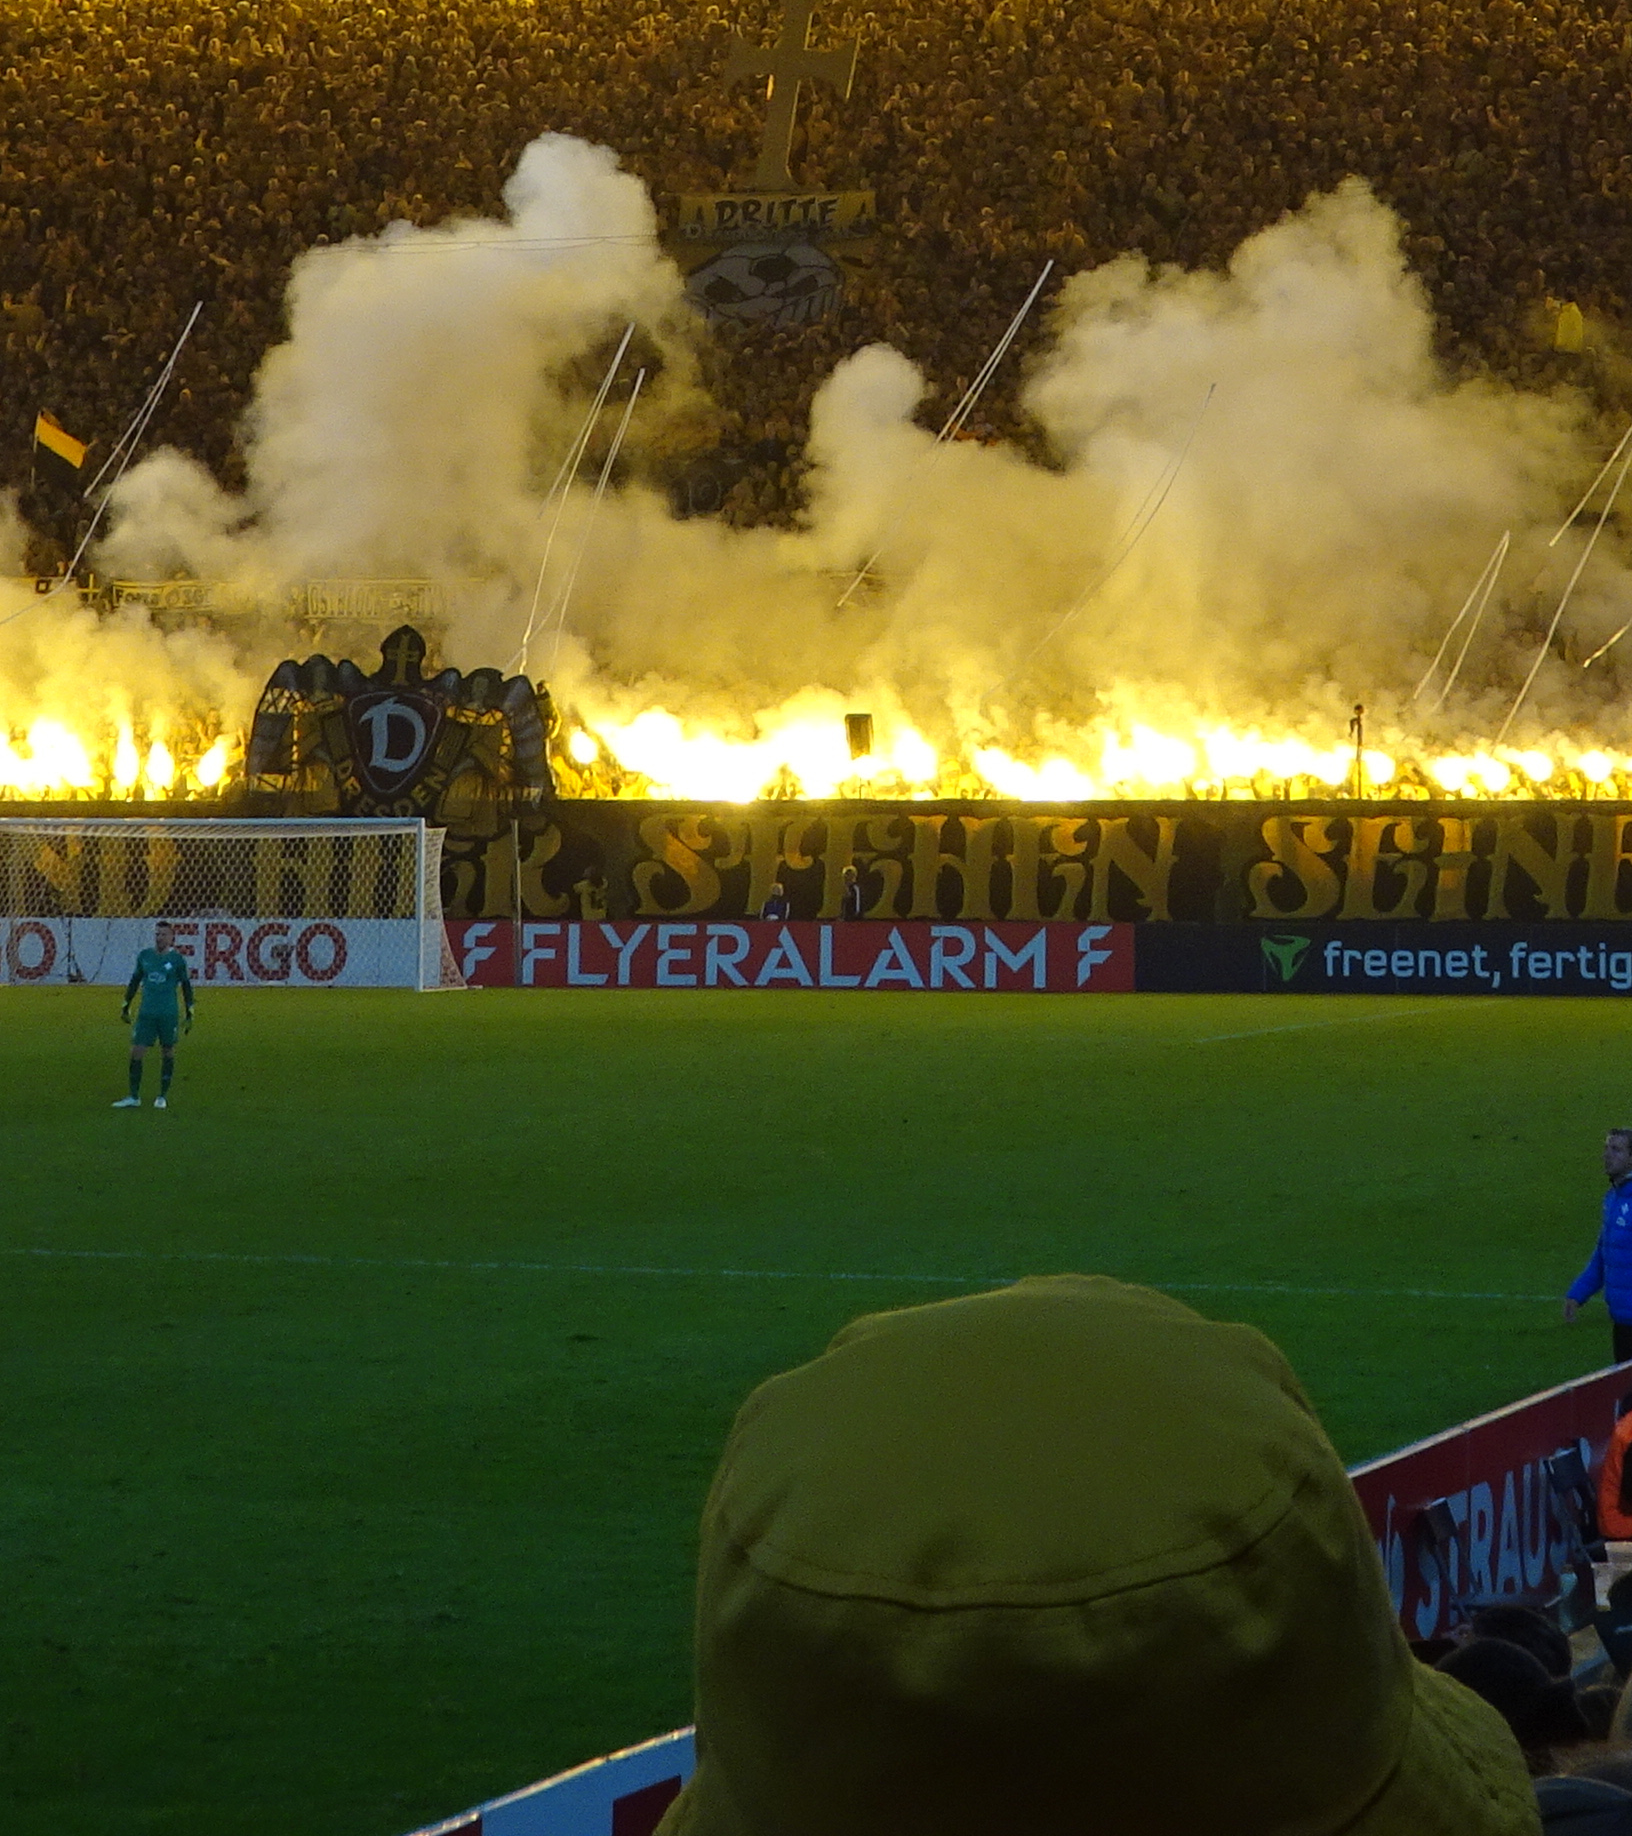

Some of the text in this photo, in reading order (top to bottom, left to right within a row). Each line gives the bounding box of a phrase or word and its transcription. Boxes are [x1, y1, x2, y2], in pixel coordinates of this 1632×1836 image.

[714, 197, 840, 228] DRITTE
[335, 758, 448, 818] DRESDEN
[632, 813, 1181, 921] STEHEN
[521, 923, 1048, 989] FLYERALARM
[1323, 940, 1501, 989] freenet,
